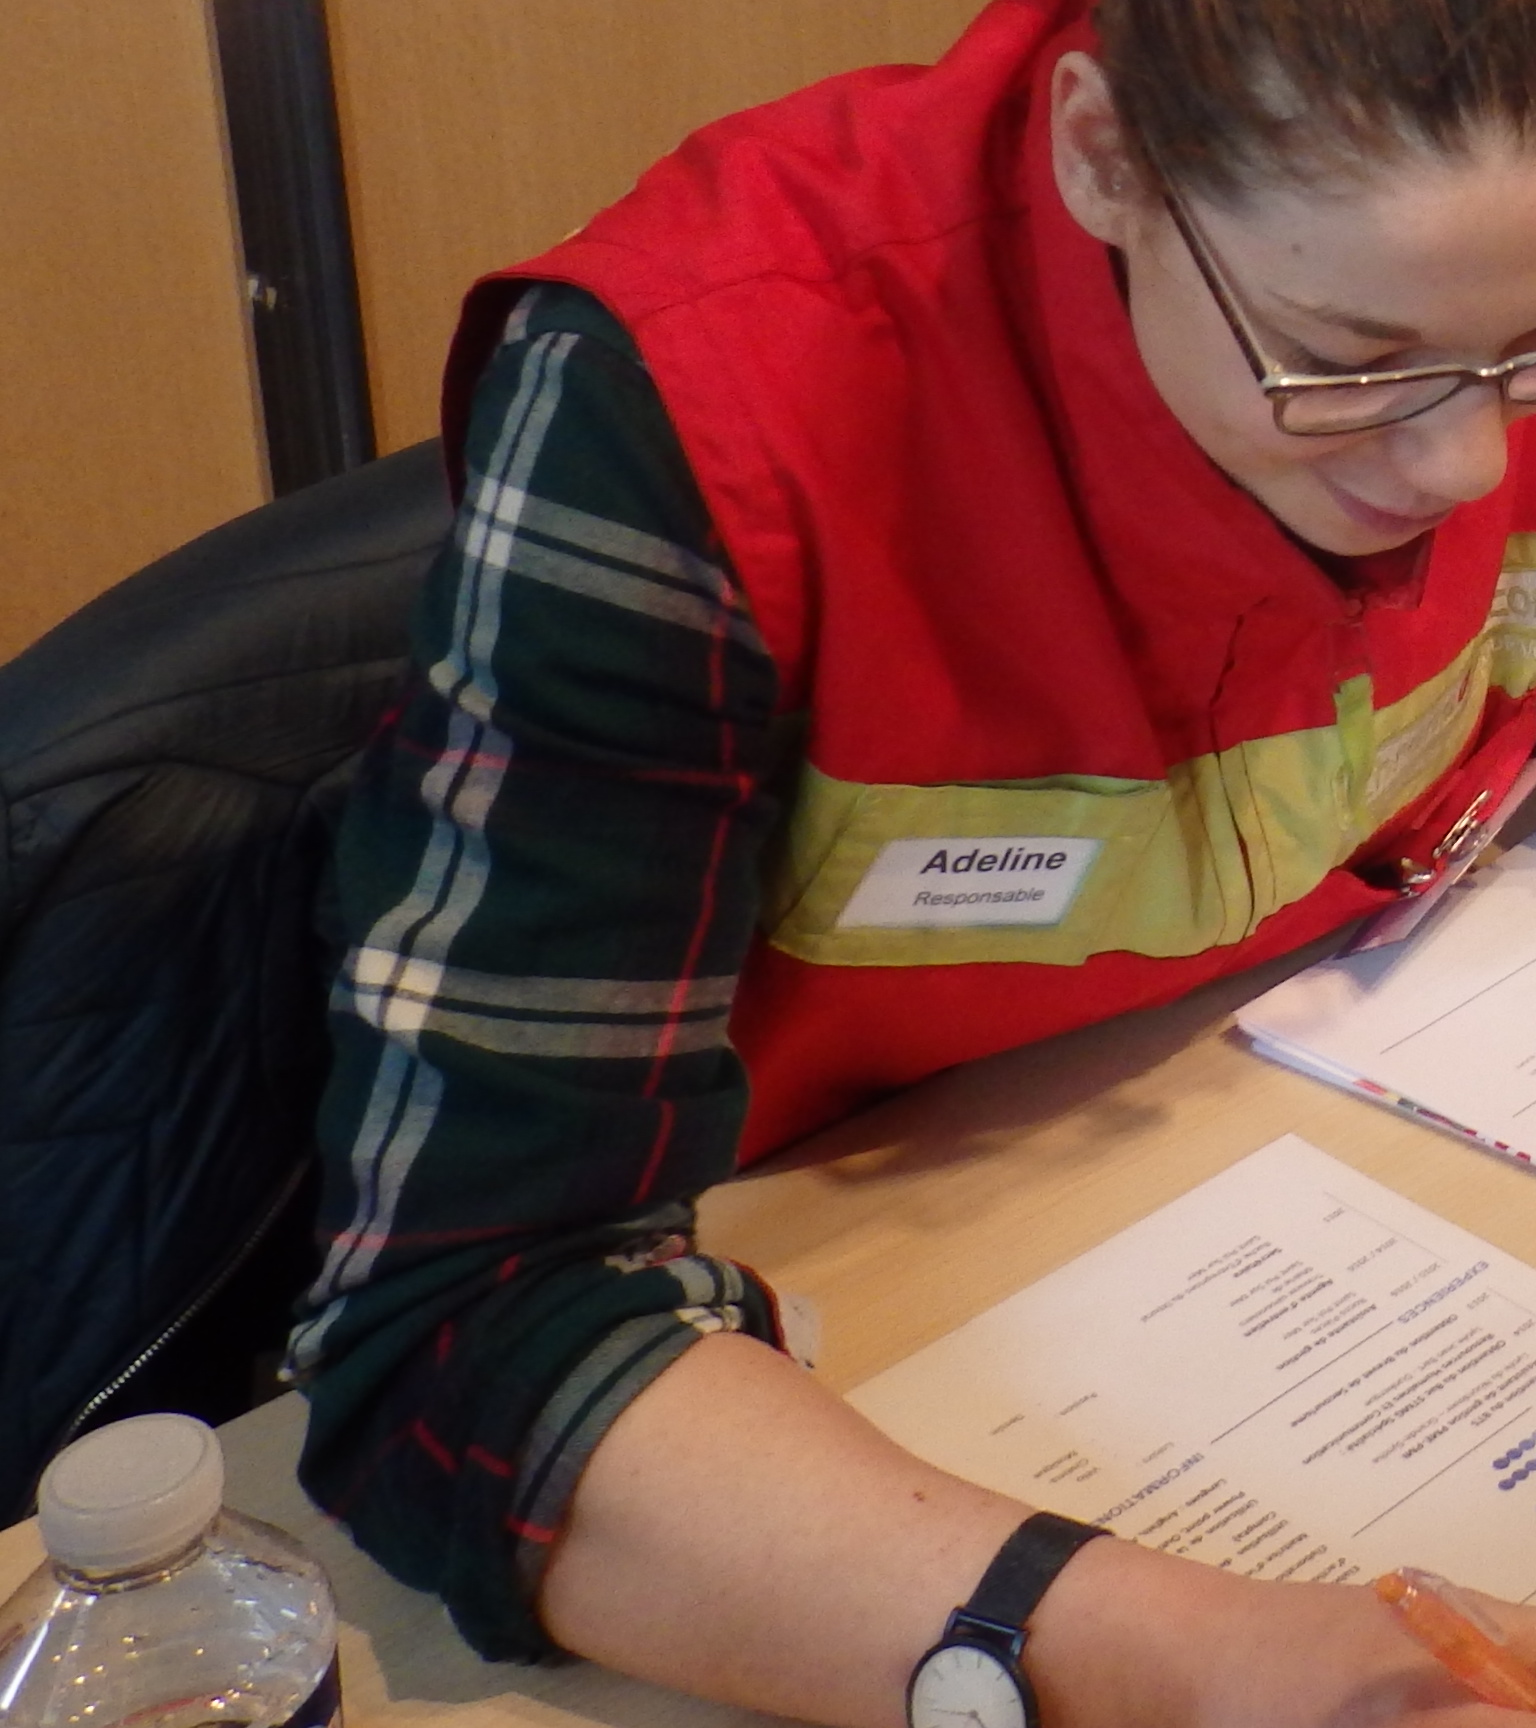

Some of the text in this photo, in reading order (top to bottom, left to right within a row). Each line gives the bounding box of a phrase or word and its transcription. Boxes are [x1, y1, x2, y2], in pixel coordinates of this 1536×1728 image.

[921, 846, 1068, 876] Adeline
[913, 885, 1046, 909] Responsable
[1395, 1258, 1489, 1326] EXPERIENCES
